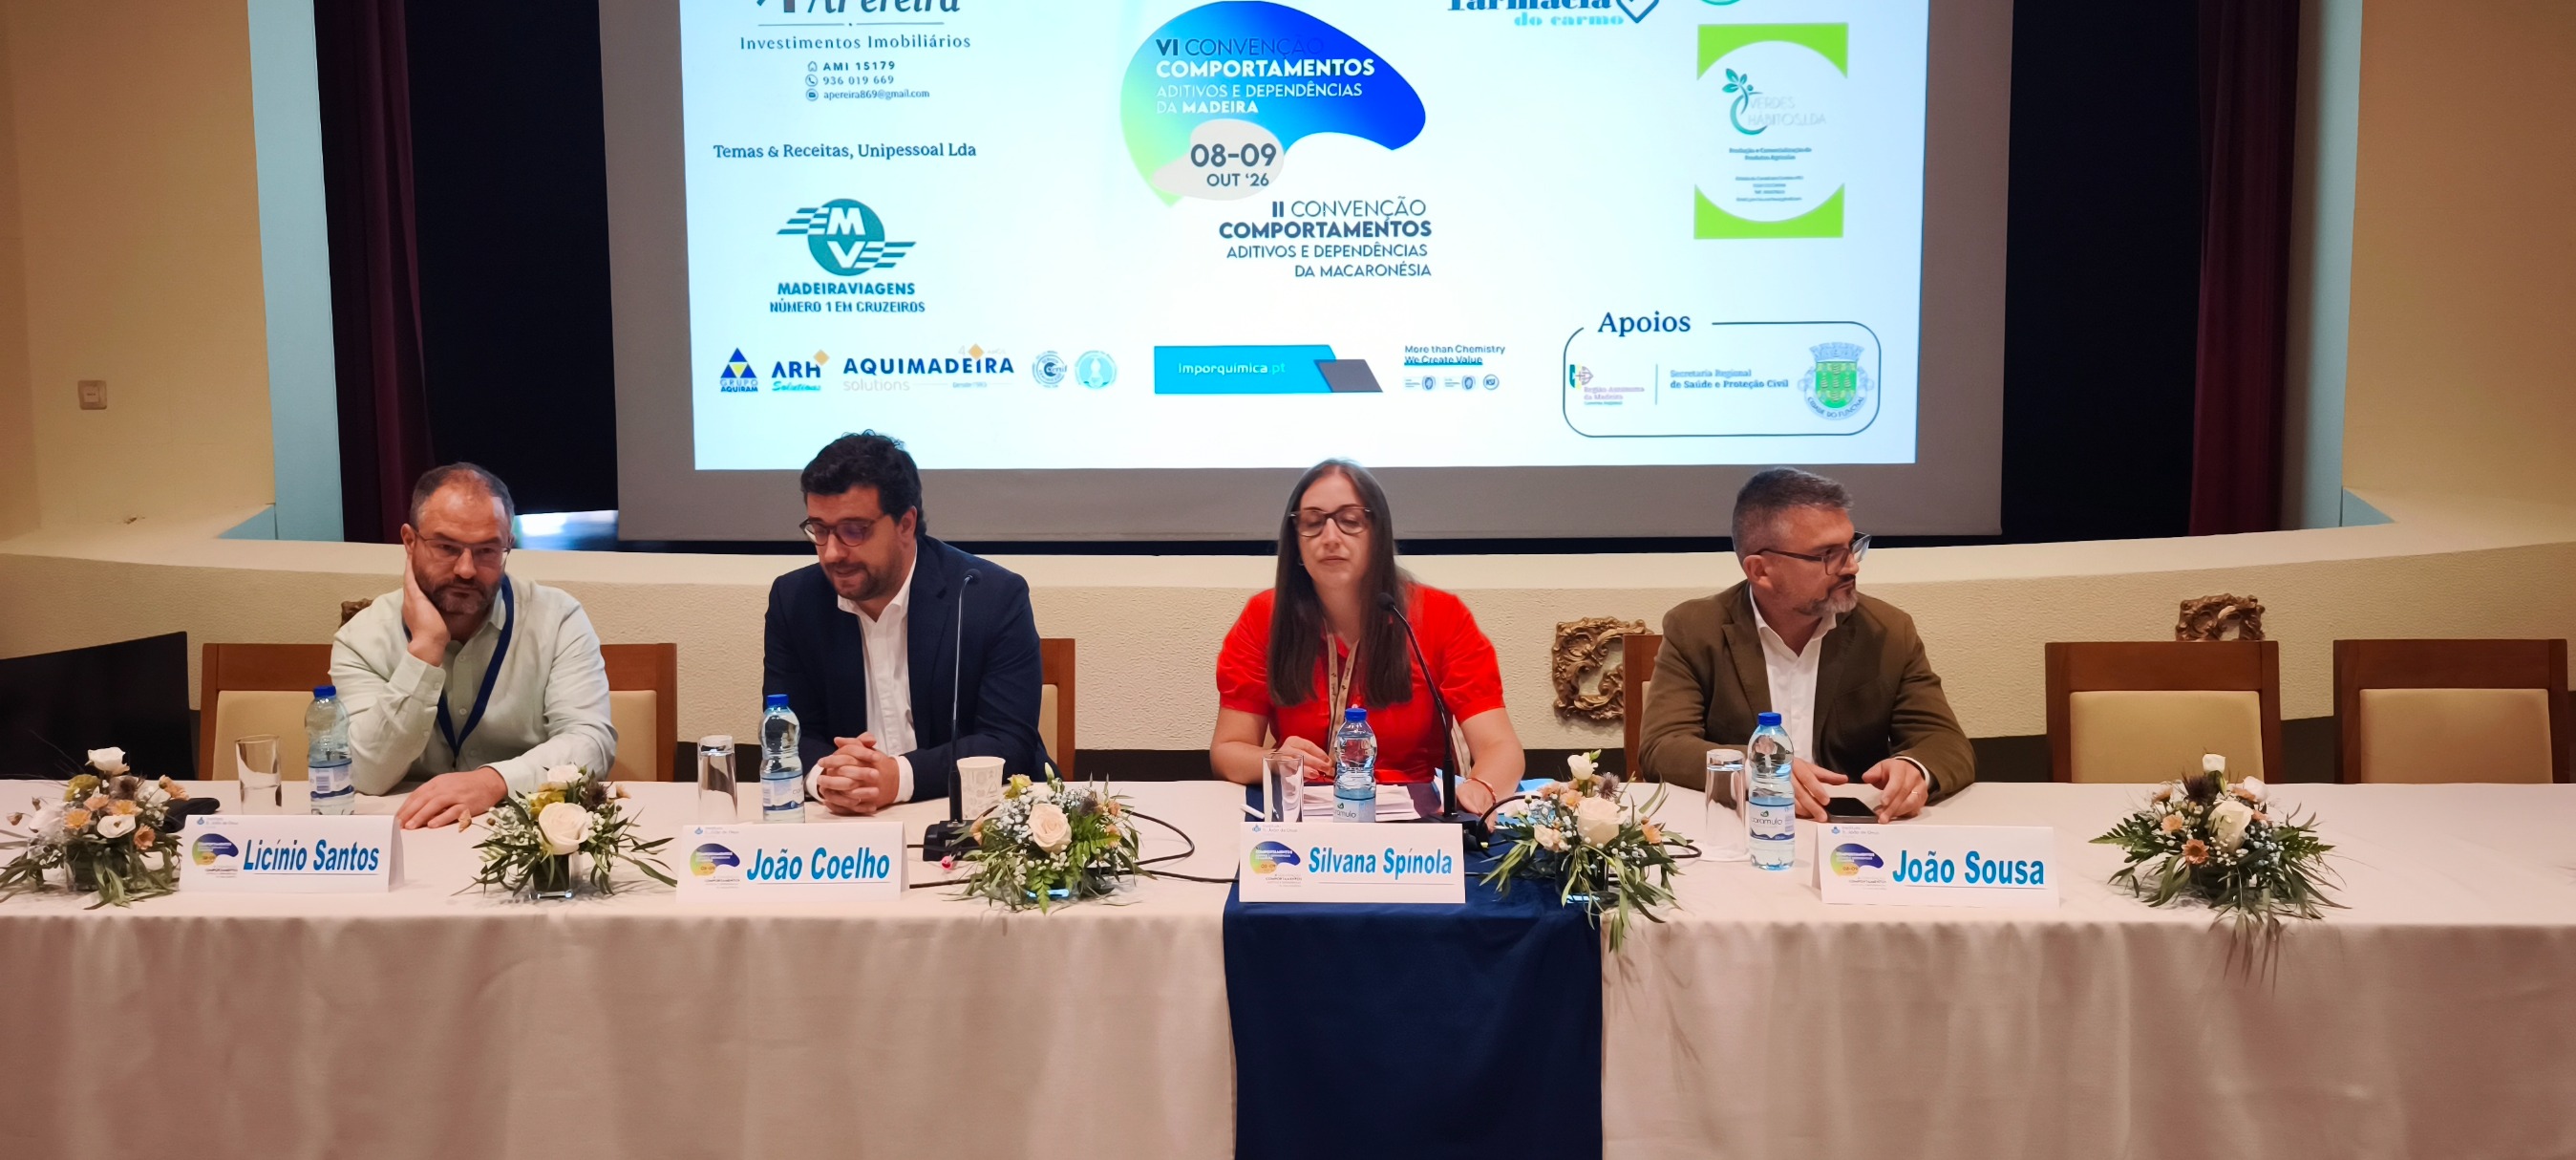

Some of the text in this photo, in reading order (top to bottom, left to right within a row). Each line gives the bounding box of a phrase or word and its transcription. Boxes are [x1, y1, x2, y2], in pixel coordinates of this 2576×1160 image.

[1514, 11, 1624, 26] do carmo
[740, 33, 971, 50] Investimentos Imobiliários
[1156, 35, 1324, 59] VI CONVENÇÃO
[822, 61, 896, 72] AMI 15179
[1156, 58, 1375, 77] COMPORTAMENTOS
[822, 75, 895, 86] 936 019 669
[1157, 80, 1363, 97] ADITIVOS E DEPENDÊNCIAS
[823, 89, 930, 101] apereira869@gmail.com
[1157, 100, 1259, 114] DA MADEIRA
[713, 143, 976, 161] Temas & Receitas, Unipessoal Lda
[1190, 143, 1277, 167] 08-09
[1206, 173, 1241, 187] OUT
[1272, 196, 1427, 222] II CONVENÇÃO
[826, 207, 866, 236] M
[1219, 220, 1432, 239] COMPORTAMENTOS
[1226, 242, 1428, 259] ADITIVOS E DEPENDÊNCIAS
[1294, 261, 1432, 278] DA MACARONÉSIA
[777, 283, 916, 296] MADEIRAVIAGENS
[770, 297, 926, 313] NÚMERO 1 EM CRUZEIROS
[1598, 311, 1692, 336] Apoios
[1404, 345, 1430, 354] More
[1455, 344, 1505, 354] Chemistry
[842, 357, 1014, 376] AQUIMADEIRA
[1405, 355, 1483, 364] We Create Value
[772, 360, 820, 378] ARH
[842, 378, 910, 392] solutions
[1671, 380, 1681, 389] de
[1684, 379, 1713, 389] Saúde
[1723, 379, 1765, 390] Proteção
[1767, 379, 1789, 388] Civil
[244, 839, 380, 871] Licínio Santos
[1309, 847, 1453, 880] Silvana Spínola
[747, 847, 890, 881] João Coelho
[1892, 849, 2045, 885] João Sousa
